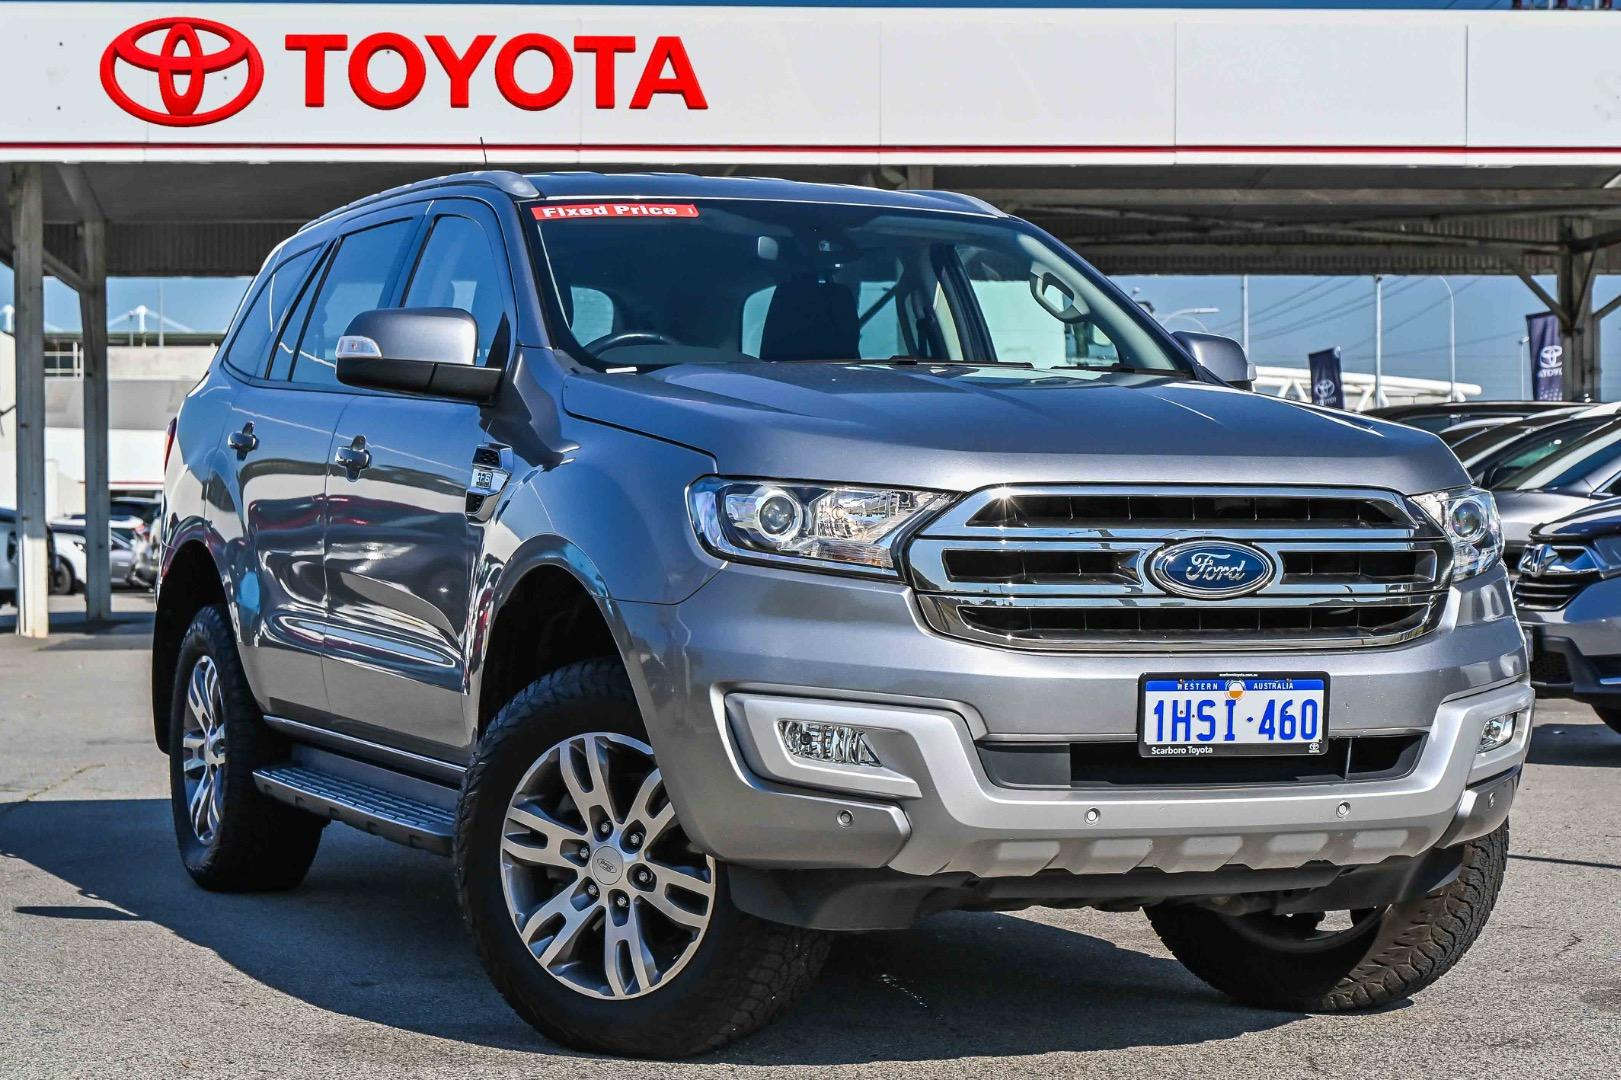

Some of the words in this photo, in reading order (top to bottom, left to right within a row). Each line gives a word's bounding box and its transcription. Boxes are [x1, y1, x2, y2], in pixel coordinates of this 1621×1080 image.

[285, 32, 708, 111] TOYOTA
[542, 206, 608, 217] Fixed
[613, 205, 677, 216] Price
[1185, 552, 1246, 581] Ford
[1253, 682, 1294, 690] AUSTRALIA
[1151, 746, 1187, 755] Scarboro
[1187, 746, 1213, 755] Toyota
